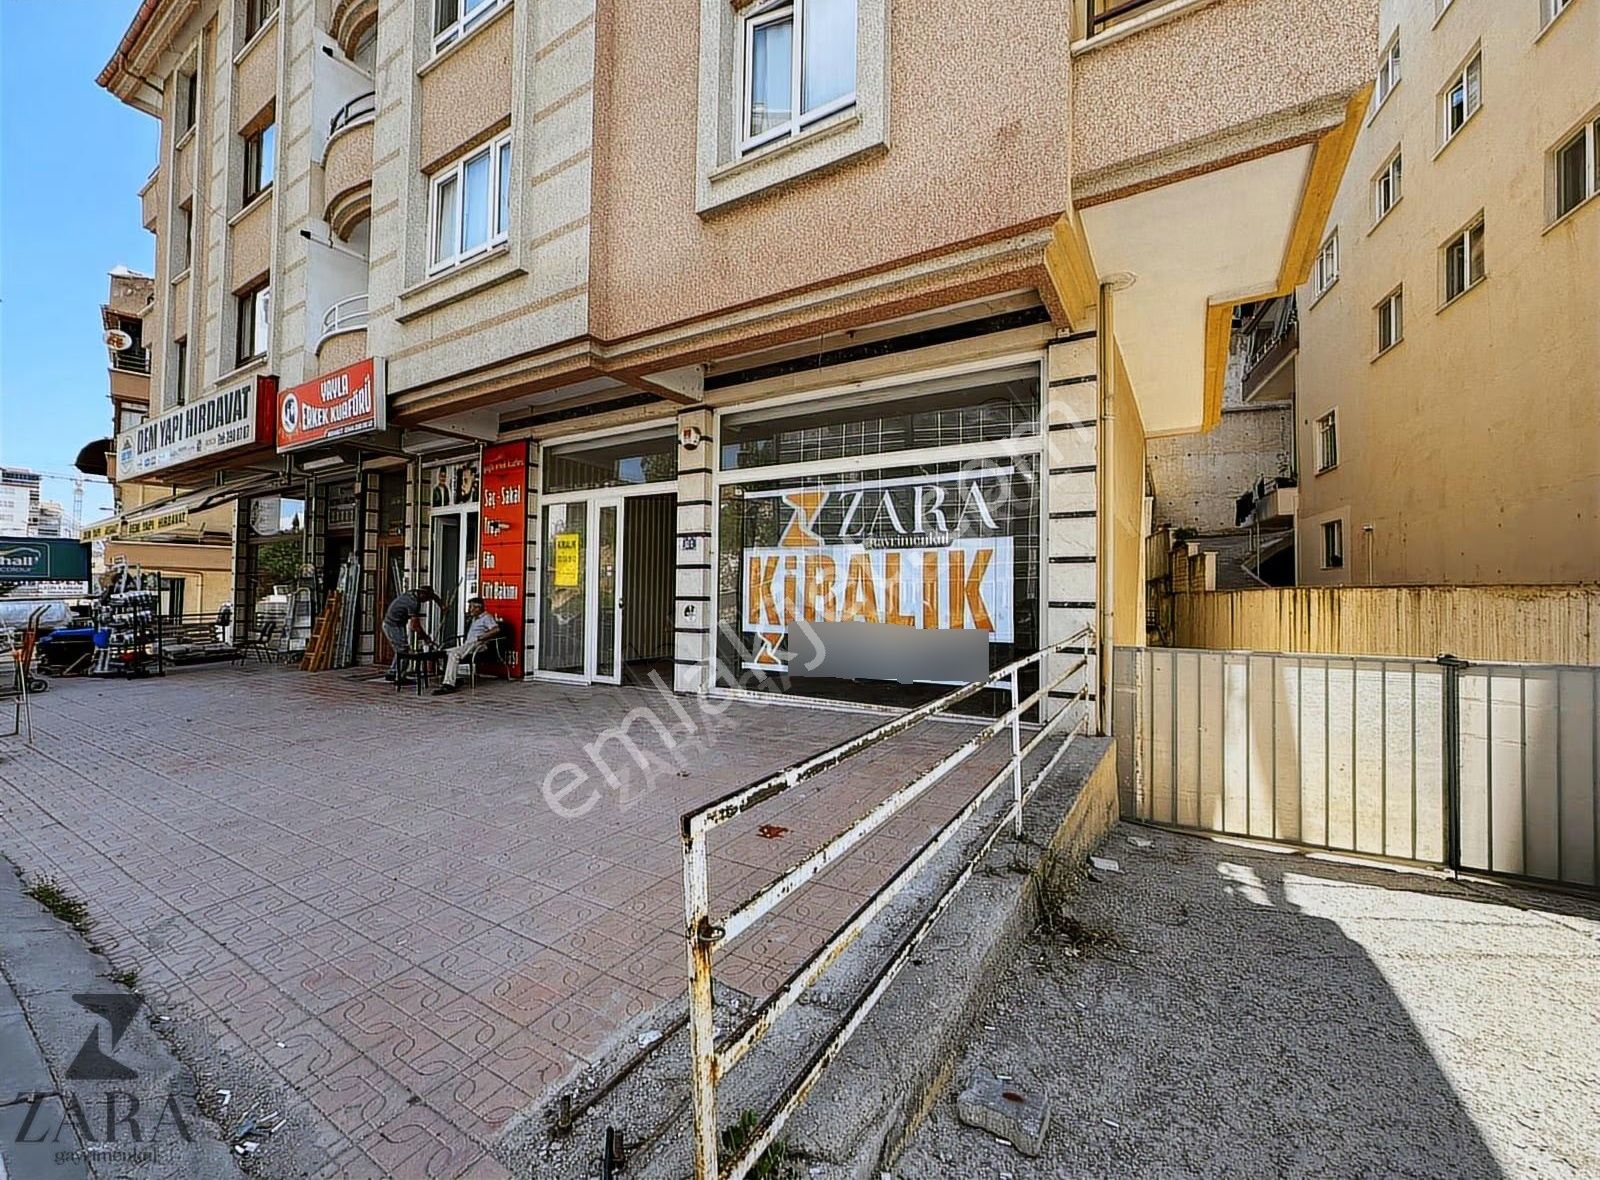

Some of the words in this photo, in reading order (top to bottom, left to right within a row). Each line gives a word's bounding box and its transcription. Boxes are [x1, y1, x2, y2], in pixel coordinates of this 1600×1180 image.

[301, 401, 330, 432] ERKEK
[329, 373, 371, 423] KUAFÖRÜ
[320, 373, 350, 403] YAYLA
[136, 422, 158, 456] DEM
[159, 411, 184, 448] YAPI
[186, 385, 252, 439] HIRDAVAT
[501, 484, 521, 505] Sakal
[838, 480, 999, 537] ZARA
